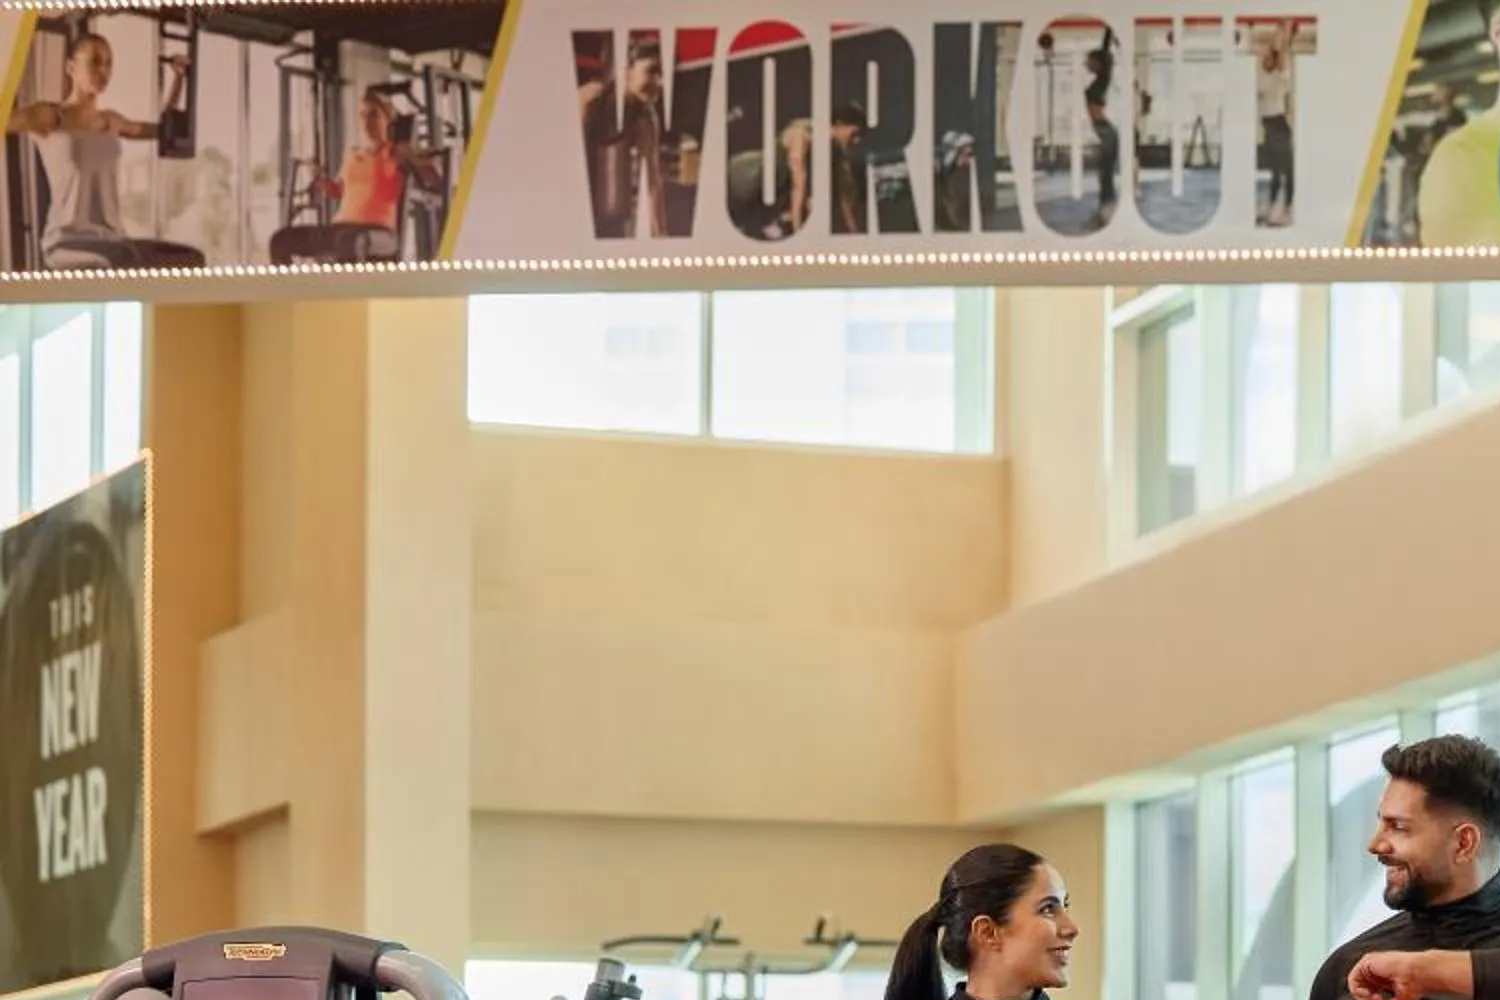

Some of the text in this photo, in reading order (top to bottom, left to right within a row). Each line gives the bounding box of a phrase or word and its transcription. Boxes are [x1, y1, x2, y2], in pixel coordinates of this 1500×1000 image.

[570, 14, 1319, 242] WORKOUT
[49, 584, 94, 640] THIS
[41, 641, 101, 759] NEW
[34, 767, 107, 882] YEAR
